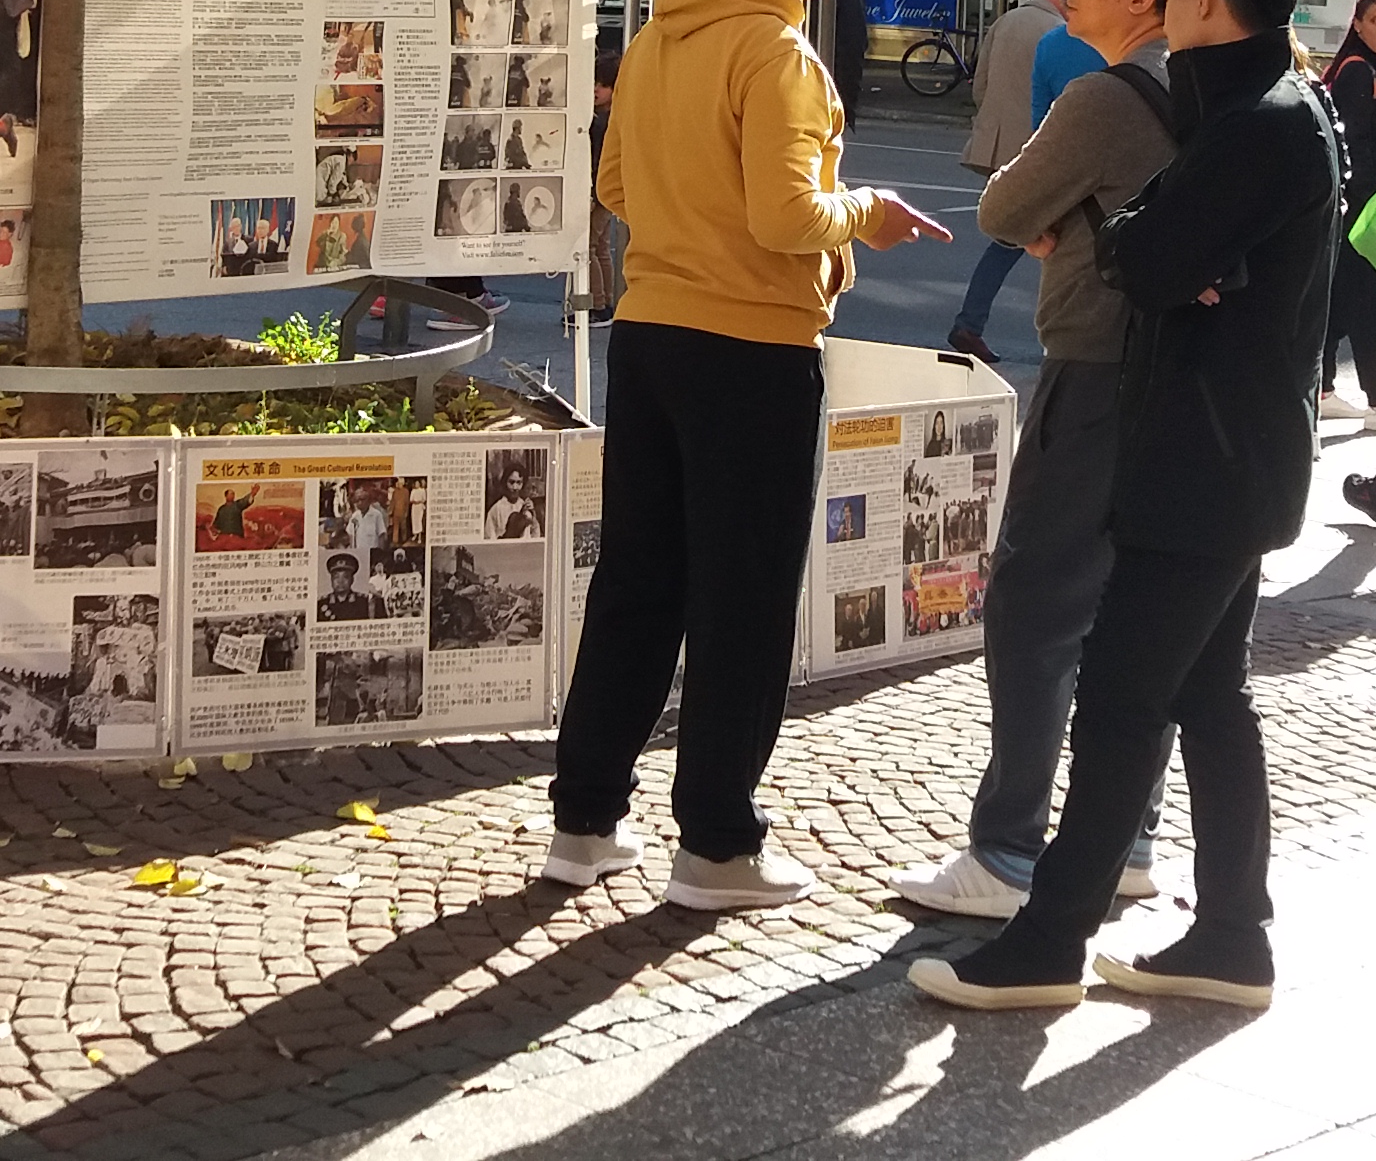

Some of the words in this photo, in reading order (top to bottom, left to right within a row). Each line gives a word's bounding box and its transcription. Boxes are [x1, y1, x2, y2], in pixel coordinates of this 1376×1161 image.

[205, 462, 281, 477] 文化大革命
